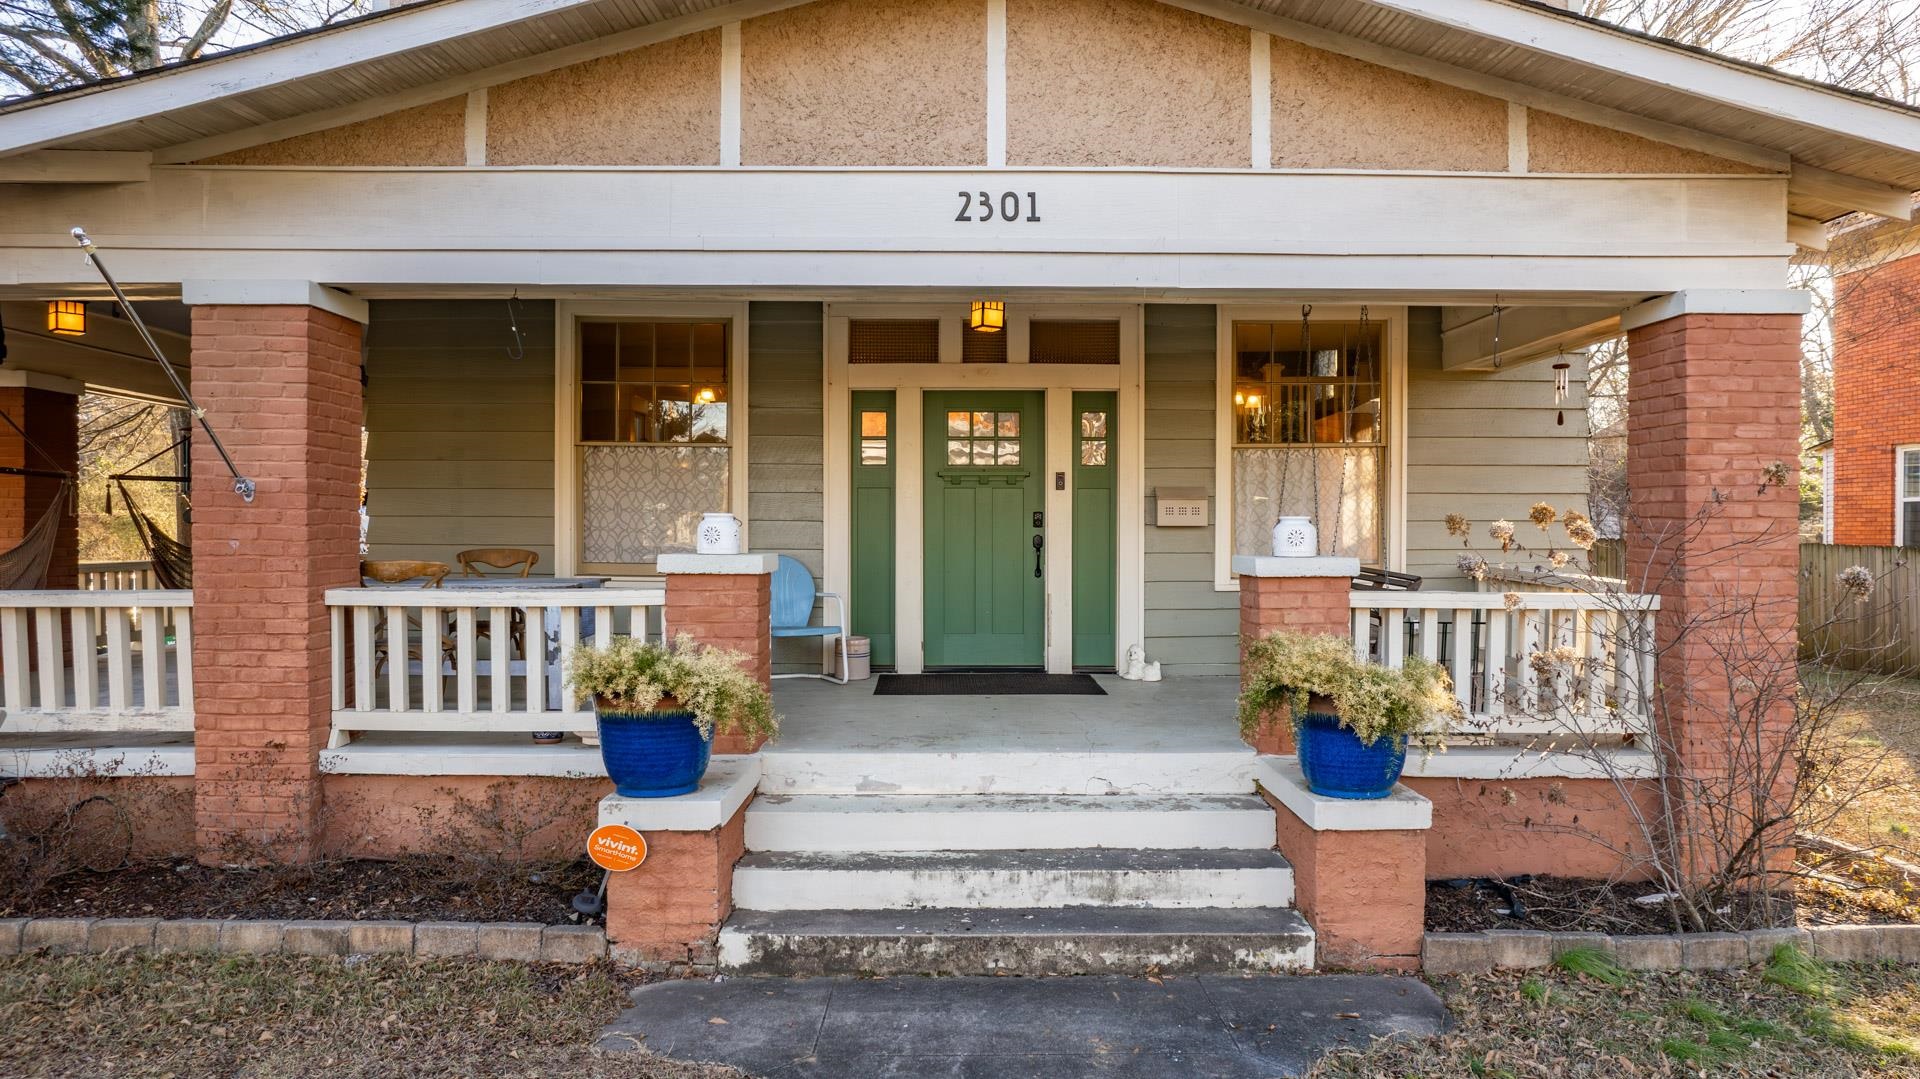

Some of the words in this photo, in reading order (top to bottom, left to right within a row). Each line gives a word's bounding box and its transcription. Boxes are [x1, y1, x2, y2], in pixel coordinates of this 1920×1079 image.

[955, 191, 1041, 222] 2301
[594, 844, 637, 862] SmartHome
[597, 837, 639, 856] vivint.
